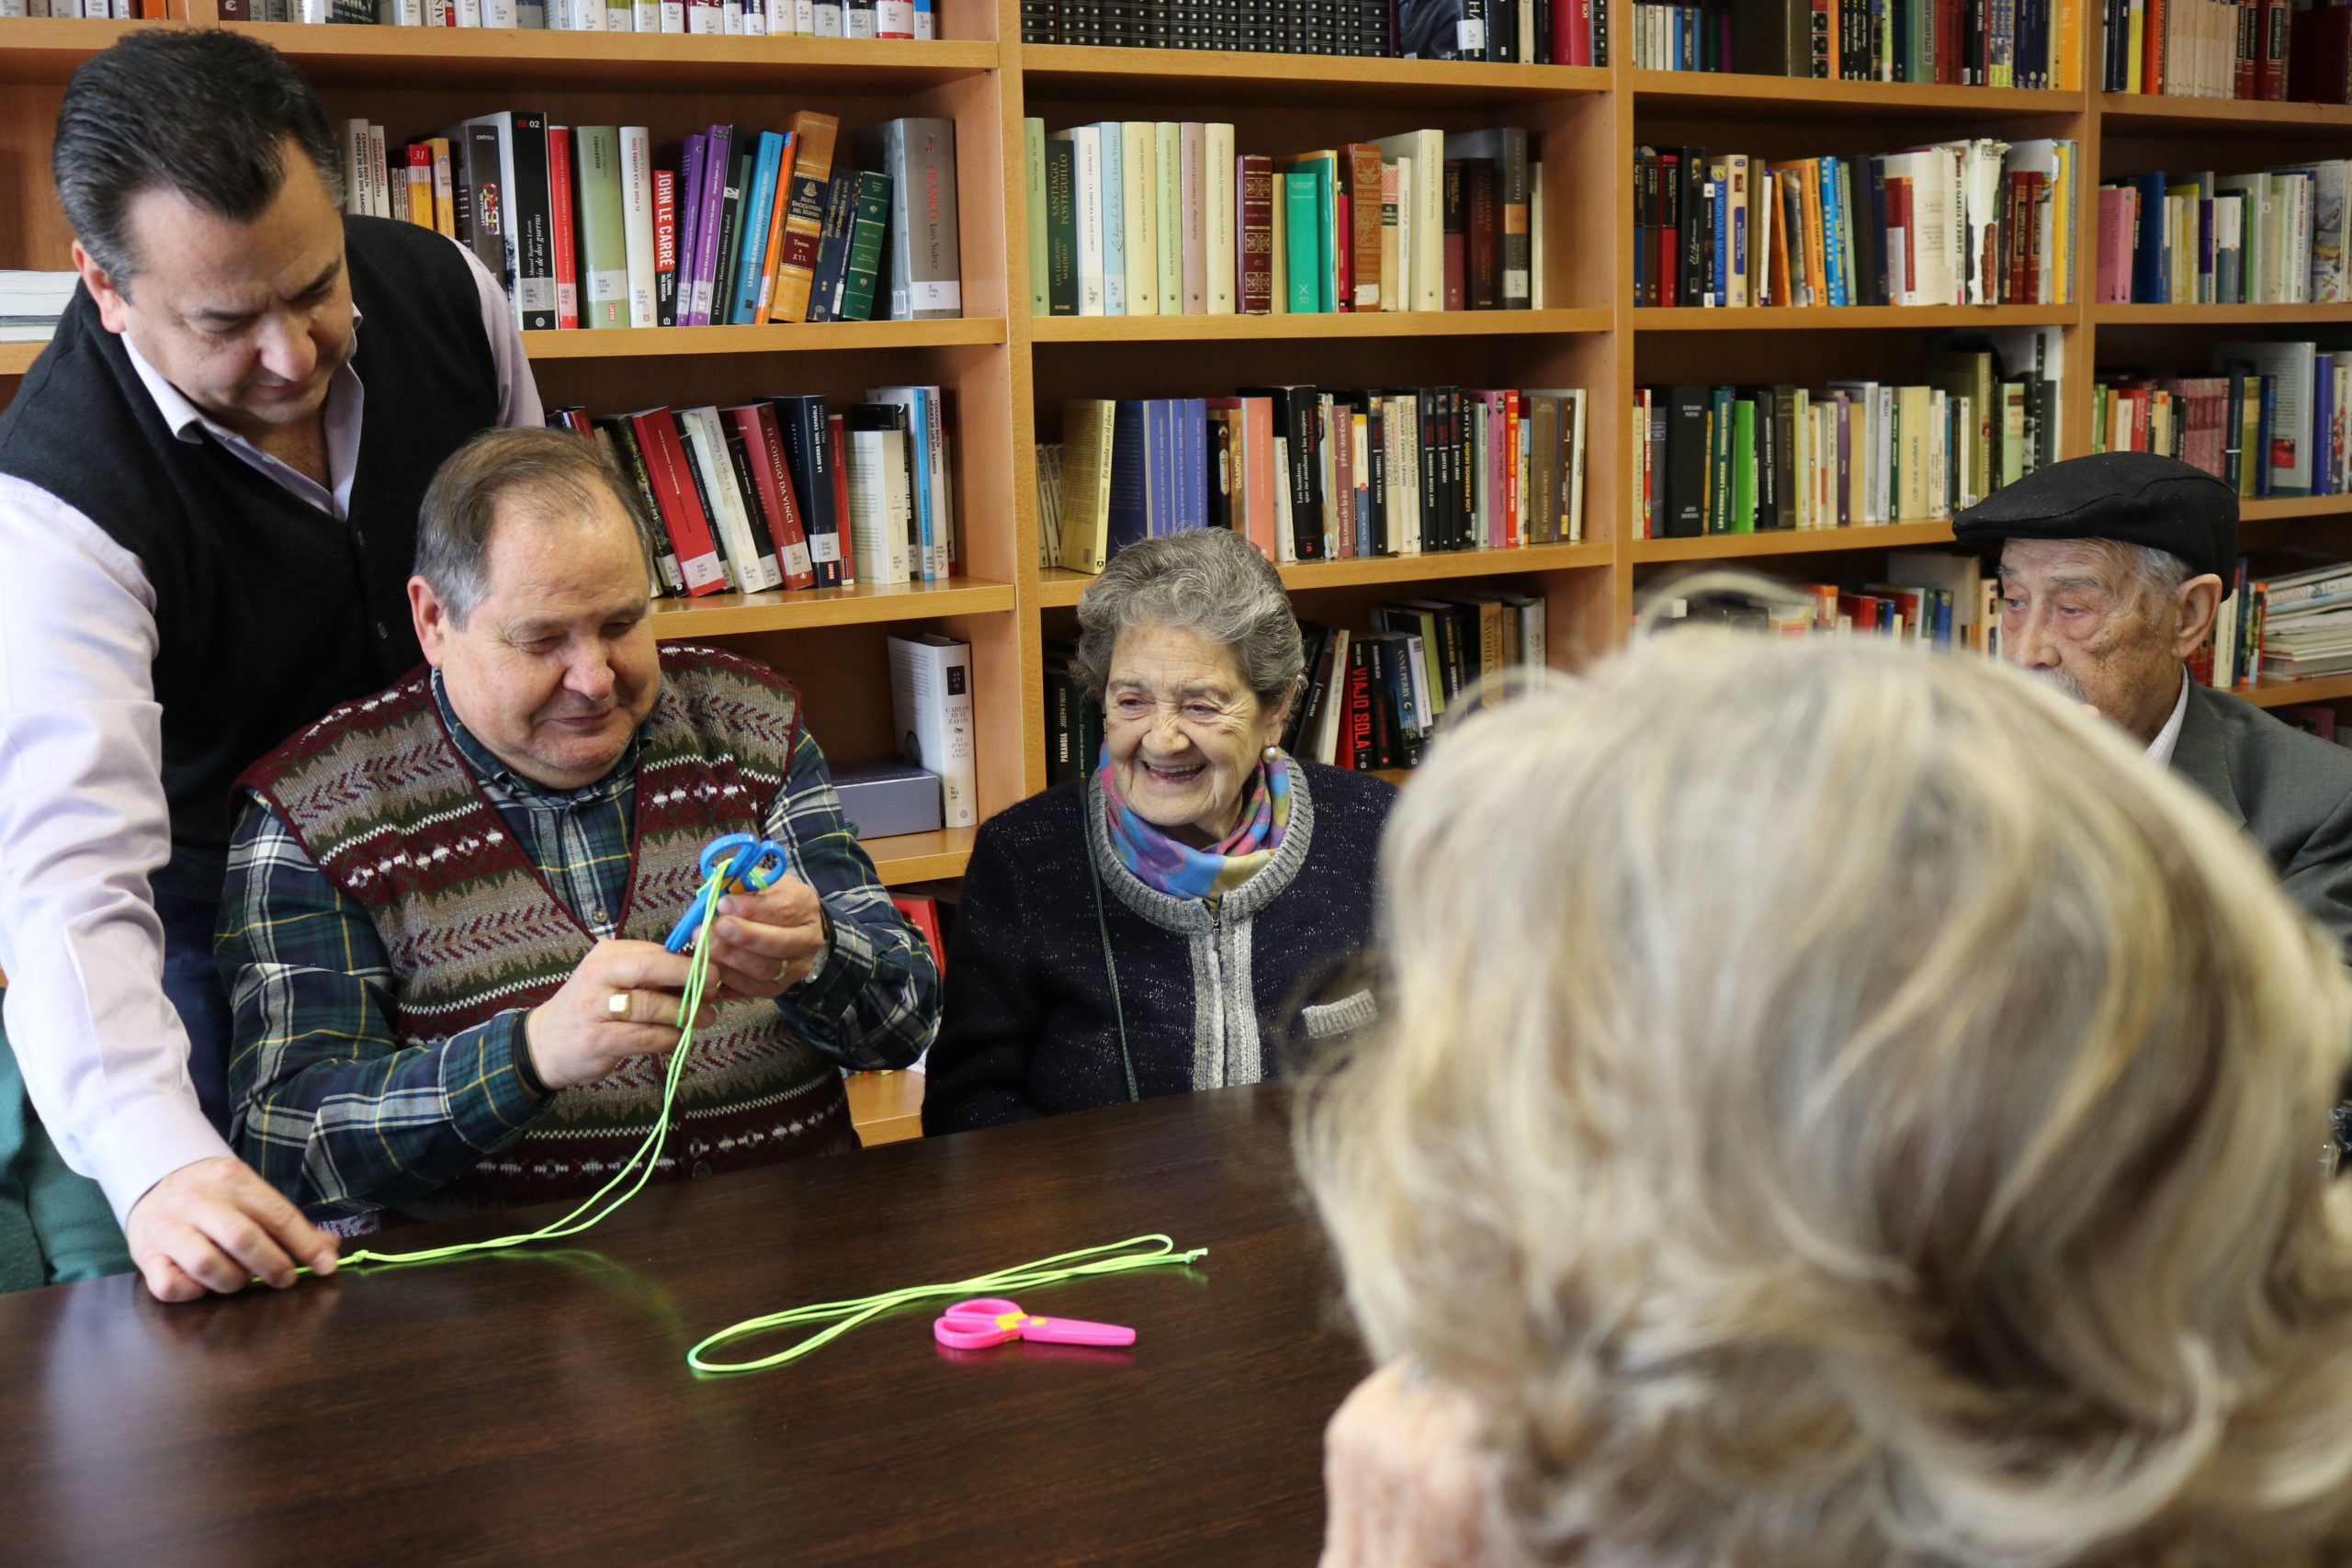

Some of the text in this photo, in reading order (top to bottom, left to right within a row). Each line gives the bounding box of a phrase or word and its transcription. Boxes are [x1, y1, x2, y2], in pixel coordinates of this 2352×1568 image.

[413, 151, 424, 160] 31
[1050, 162, 1059, 217] SANTIAGO
[1059, 153, 1069, 224] POSTEGUILLO
[533, 214, 544, 243] guerras
[658, 173, 675, 267] JOHN LE CARRÉ
[1337, 412, 1346, 448] steinbeck
[766, 427, 794, 524] EL CÓDIGO DA VINCI
[1339, 449, 1349, 467] john
[1304, 481, 1308, 490] no
[1340, 507, 1349, 518] de
[1484, 615, 1492, 661] BROWN
[1397, 649, 1410, 698] ANNE PERRY
[1351, 667, 1371, 750] VIAJO SOLA
[1059, 732, 1069, 762] PARANOIA
